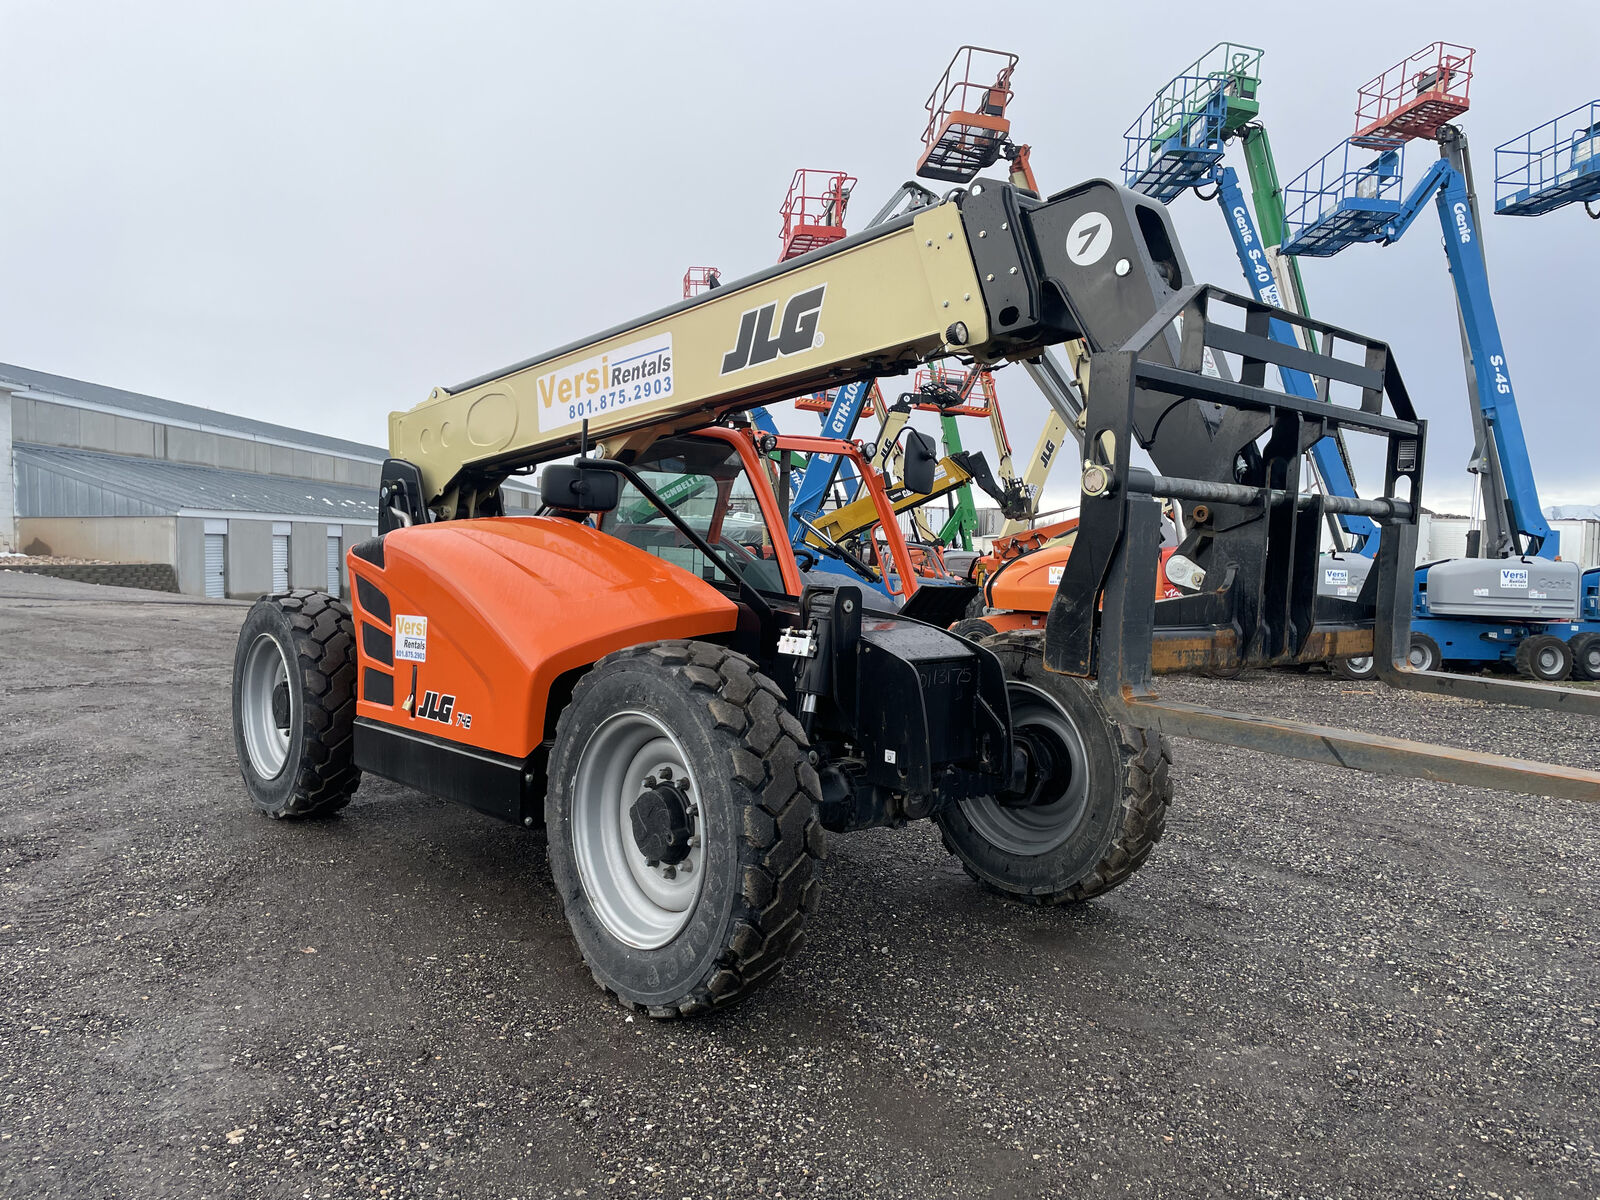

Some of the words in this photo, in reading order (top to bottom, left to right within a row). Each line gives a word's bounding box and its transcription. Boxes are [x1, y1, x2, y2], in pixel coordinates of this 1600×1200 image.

[1077, 223, 1102, 257] 7
[1454, 202, 1471, 244] Genie
[1248, 248, 1270, 282] S-40
[721, 284, 827, 375] JLG
[538, 355, 609, 409] Versi
[611, 354, 671, 388] Rentals
[1490, 354, 1510, 394] S-45
[569, 376, 672, 419] 801.875.2903
[1040, 439, 1056, 469] JLG
[1502, 570, 1527, 579] Versi
[397, 616, 426, 637] Versi
[404, 639, 426, 650] Rentals
[416, 690, 456, 724] JLG
[455, 712, 472, 730] 742
